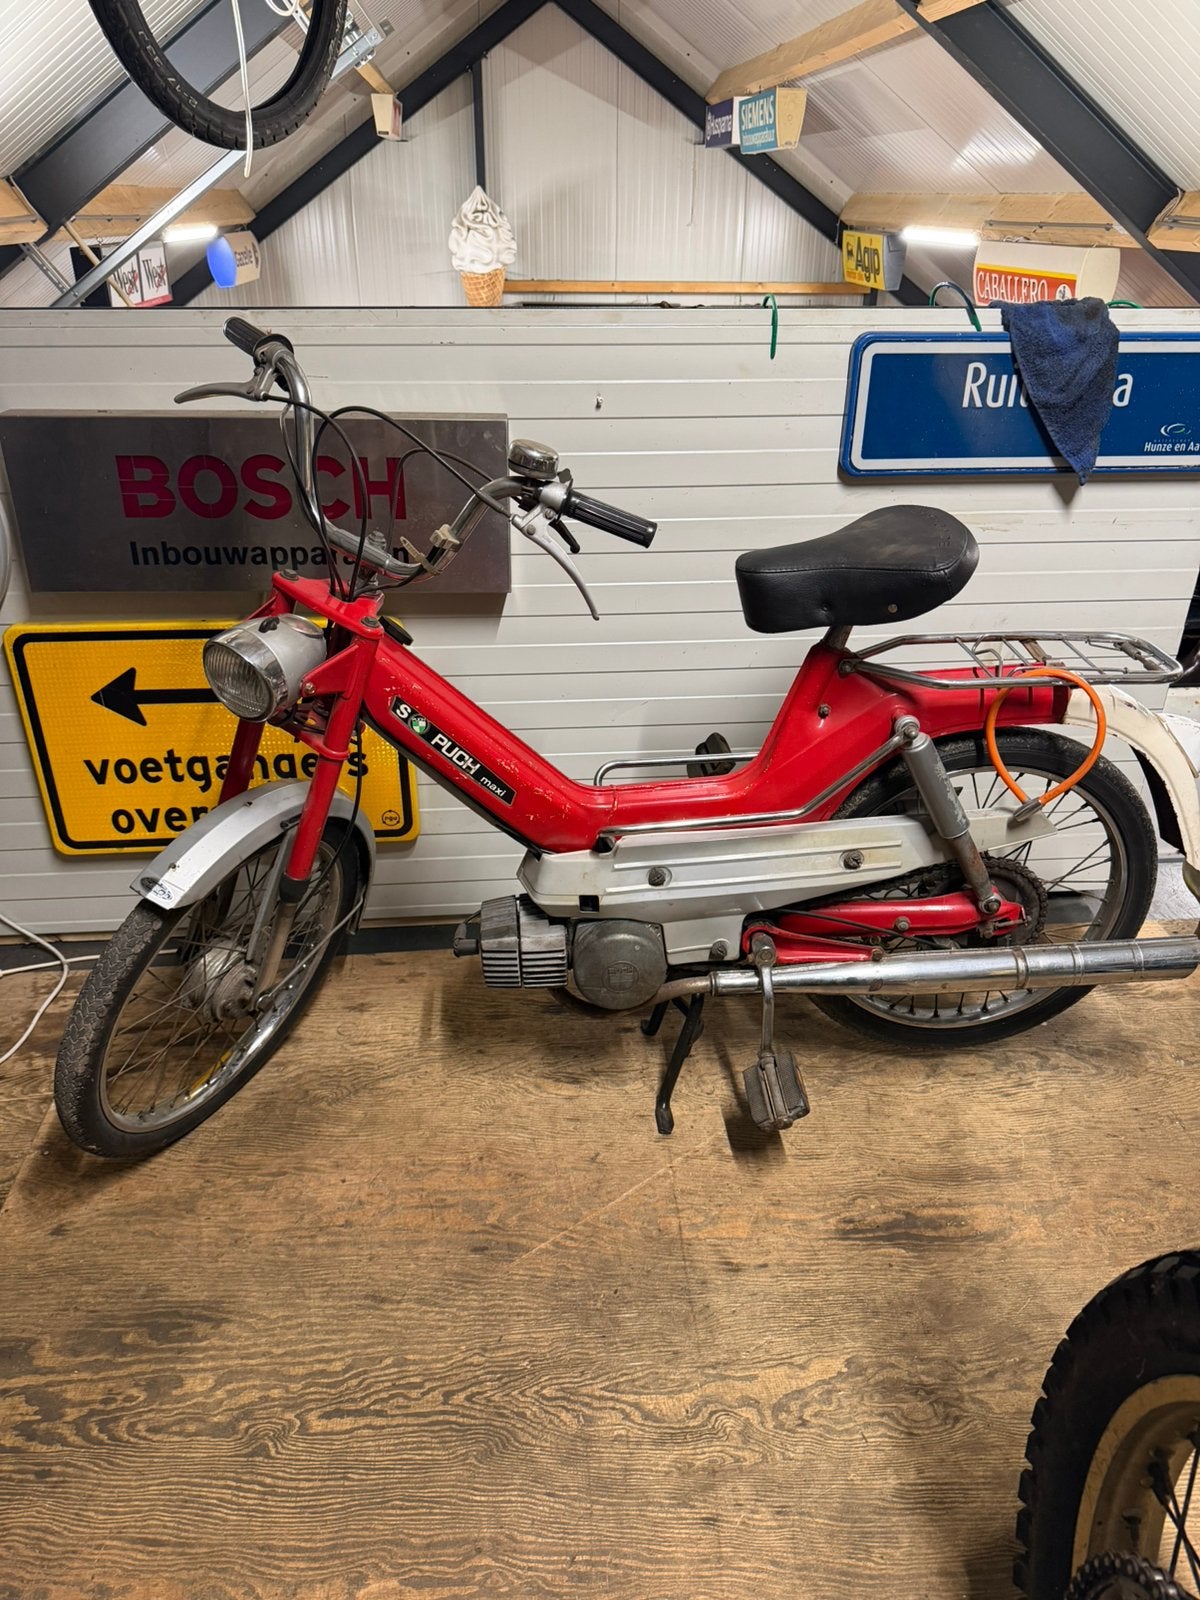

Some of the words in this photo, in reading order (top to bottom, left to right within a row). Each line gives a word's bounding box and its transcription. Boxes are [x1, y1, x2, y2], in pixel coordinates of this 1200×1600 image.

[741, 95, 775, 131] SIEMENS
[855, 236, 881, 284] Agip
[977, 271, 1049, 304] CABALLERO
[962, 362, 1029, 409] Rui
[1144, 441, 1173, 452] Hunze
[1174, 443, 1187, 452] en
[115, 454, 407, 521] BOSCH
[396, 704, 412, 719] S
[430, 733, 481, 775] PUCH
[480, 776, 507, 797] maxi
